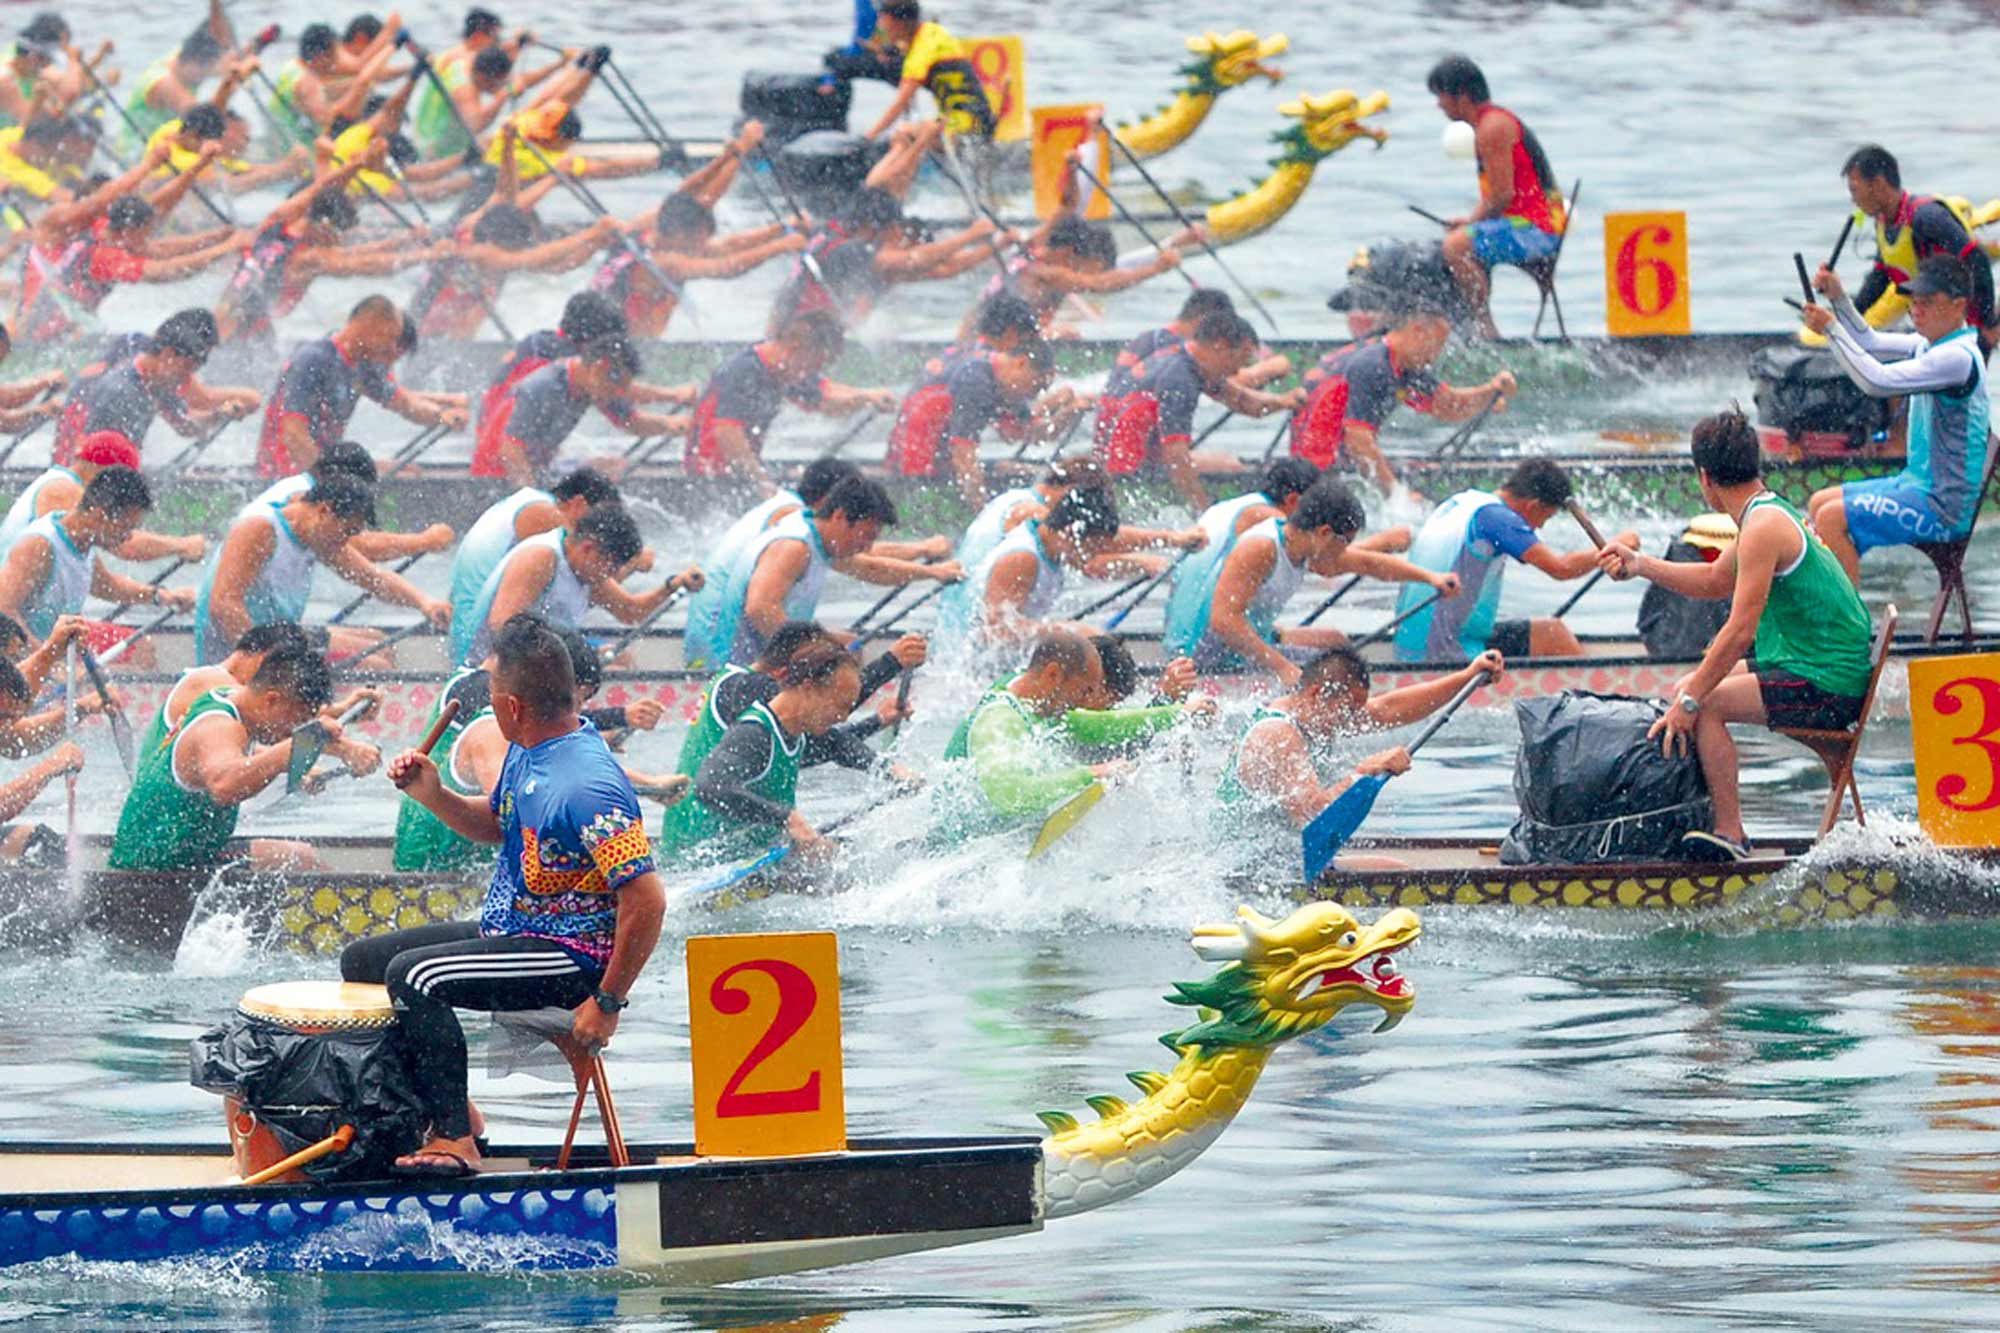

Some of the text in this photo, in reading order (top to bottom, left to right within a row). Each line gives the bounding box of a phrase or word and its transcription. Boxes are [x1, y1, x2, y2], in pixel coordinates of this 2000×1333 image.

[1041, 116, 1091, 197] 7
[1615, 223, 1677, 317] 6
[1933, 676, 2000, 812] 3
[710, 959, 820, 1118] 2
